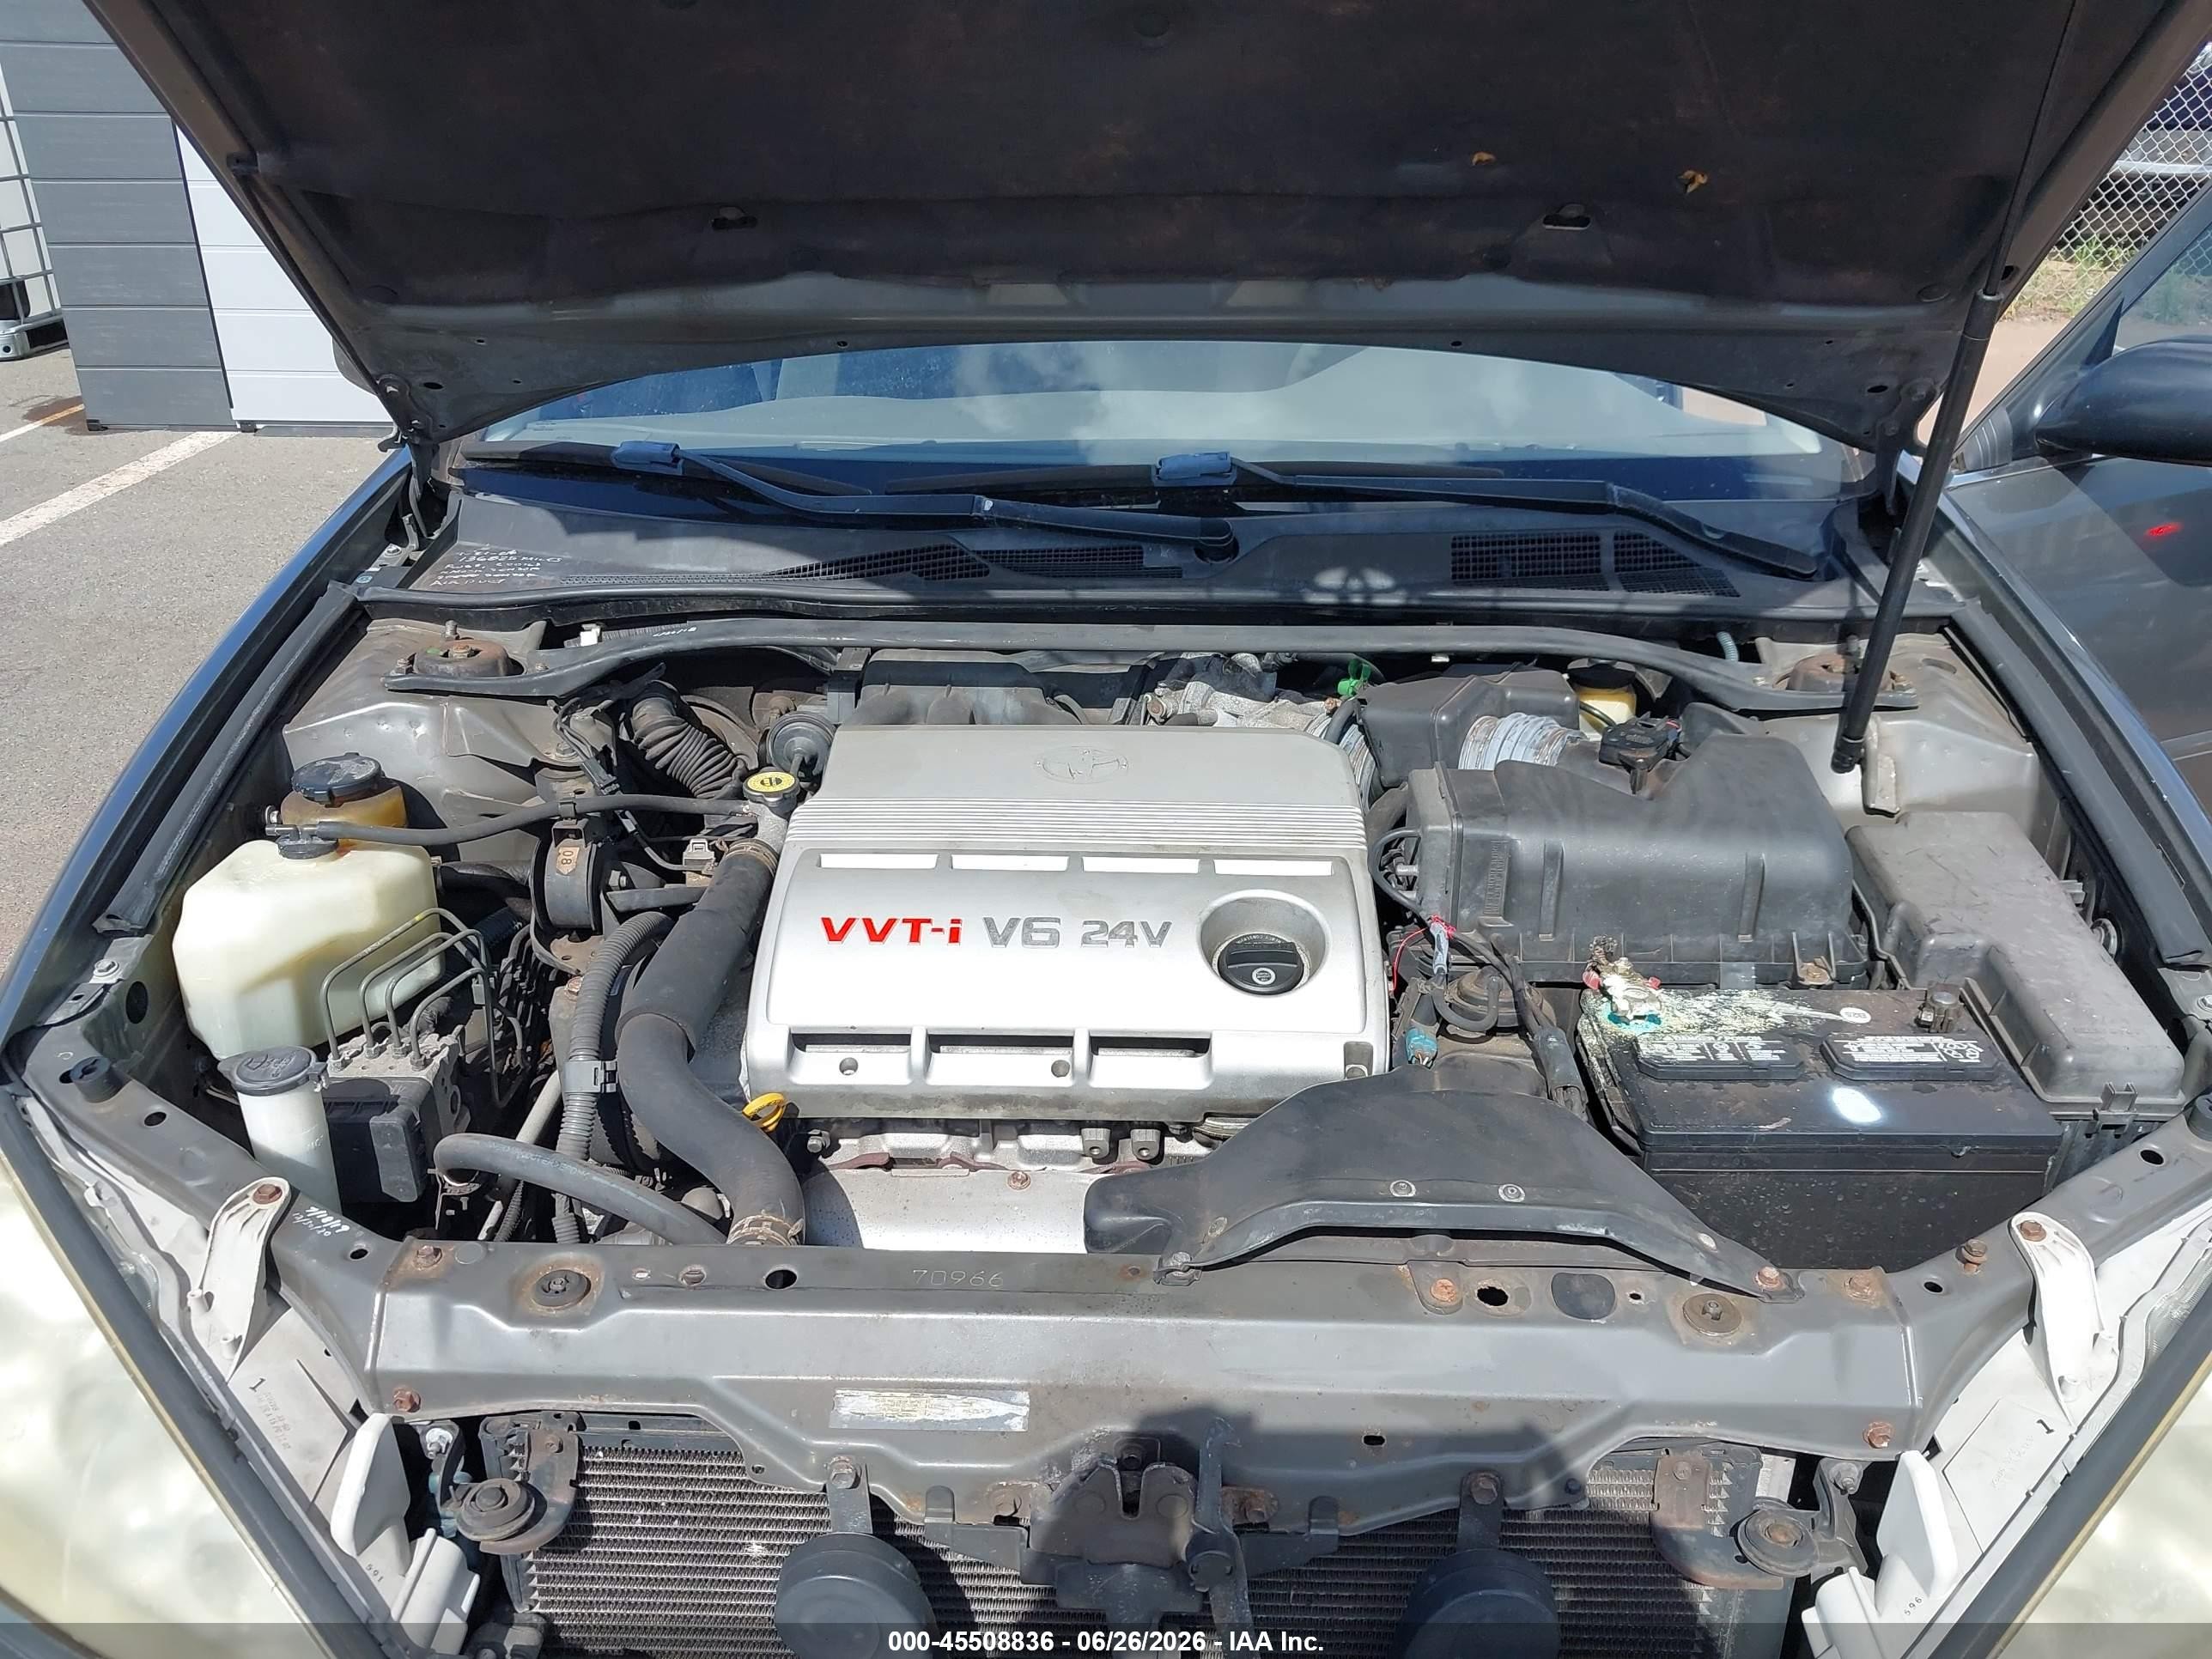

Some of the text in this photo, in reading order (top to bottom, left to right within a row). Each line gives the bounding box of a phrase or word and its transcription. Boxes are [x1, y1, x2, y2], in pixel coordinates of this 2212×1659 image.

[561, 850, 574, 866] 08
[821, 916, 1173, 949] VVT-i V6 24V
[913, 1269, 1004, 1287] 70966
[248, 1376, 266, 1393] 1
[2036, 1419, 2055, 1435] 1
